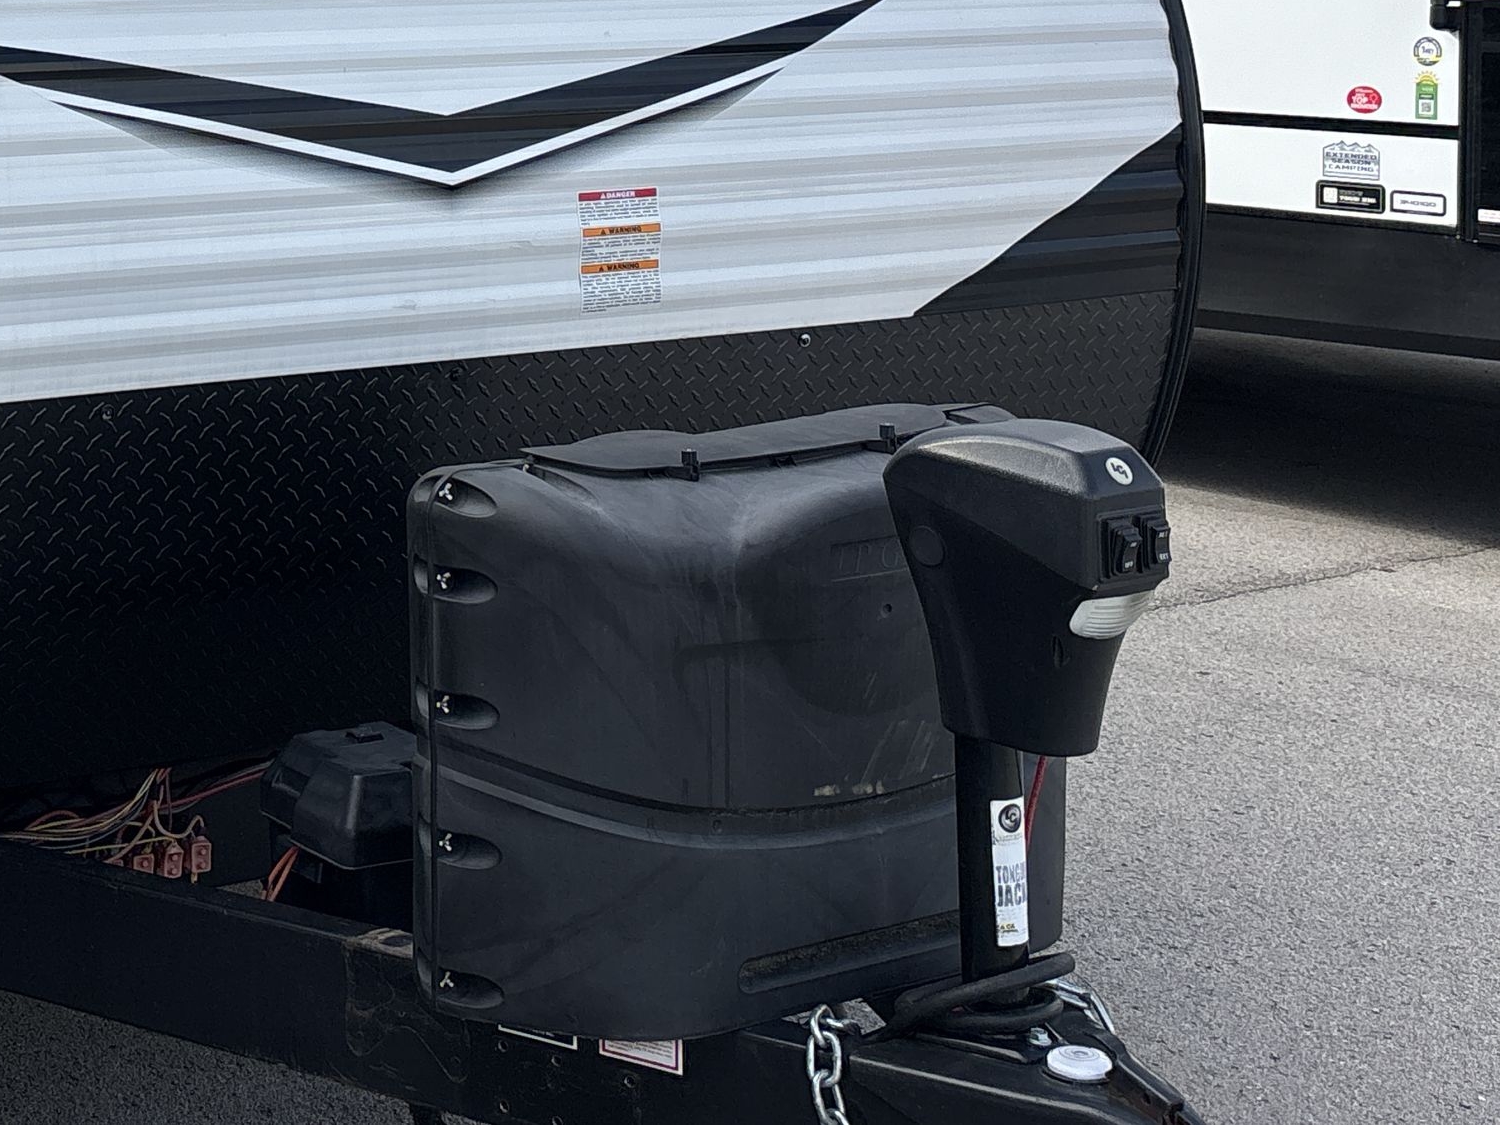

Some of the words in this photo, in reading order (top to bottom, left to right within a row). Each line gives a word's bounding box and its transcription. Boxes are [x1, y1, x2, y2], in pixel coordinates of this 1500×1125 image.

[1325, 151, 1377, 161] EXTENDED
[1330, 157, 1372, 166] SEASON
[1328, 163, 1375, 172] CAMPING
[606, 190, 636, 199] DANGER
[608, 225, 642, 235] WARNING
[606, 262, 640, 272] WARNING
